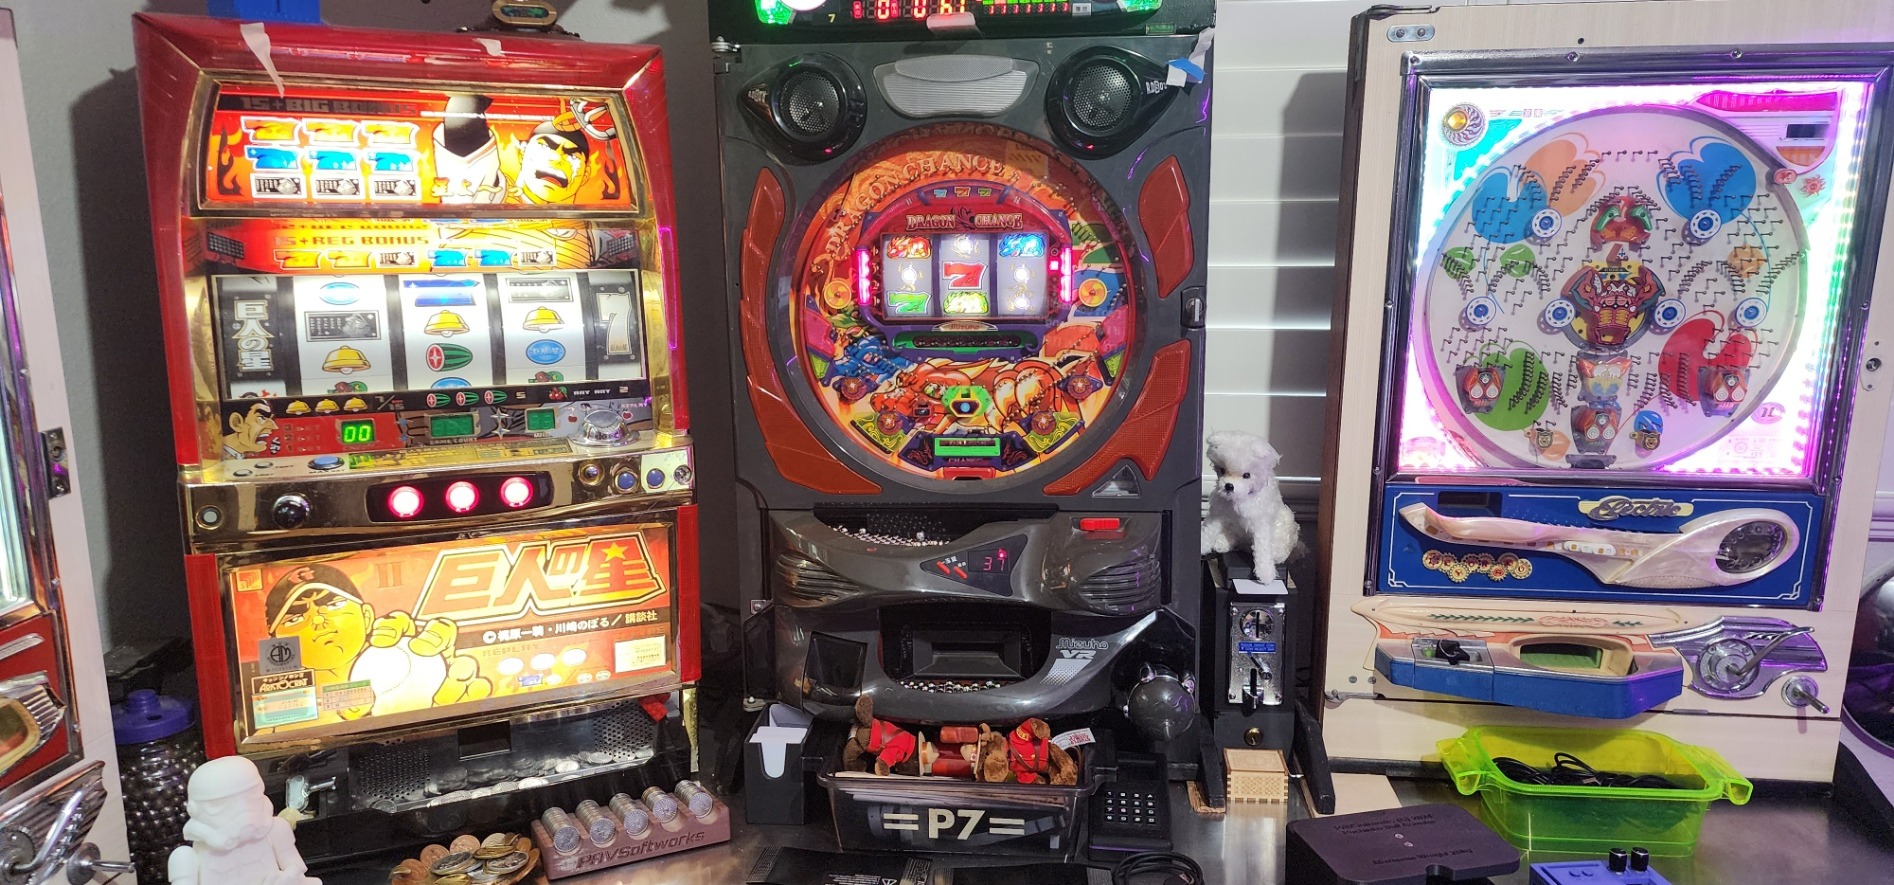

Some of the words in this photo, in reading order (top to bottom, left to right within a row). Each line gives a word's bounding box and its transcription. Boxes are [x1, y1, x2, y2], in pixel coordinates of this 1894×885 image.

[903, 153, 1009, 180] CHANCE
[906, 214, 957, 230] DRAGON
[974, 213, 1024, 229] CHANCE
[232, 299, 275, 373] 巨人の星
[343, 424, 372, 443] 00
[414, 536, 664, 620] 巨人の星
[1055, 637, 1109, 650] Mizuho
[1060, 649, 1096, 660] VR
